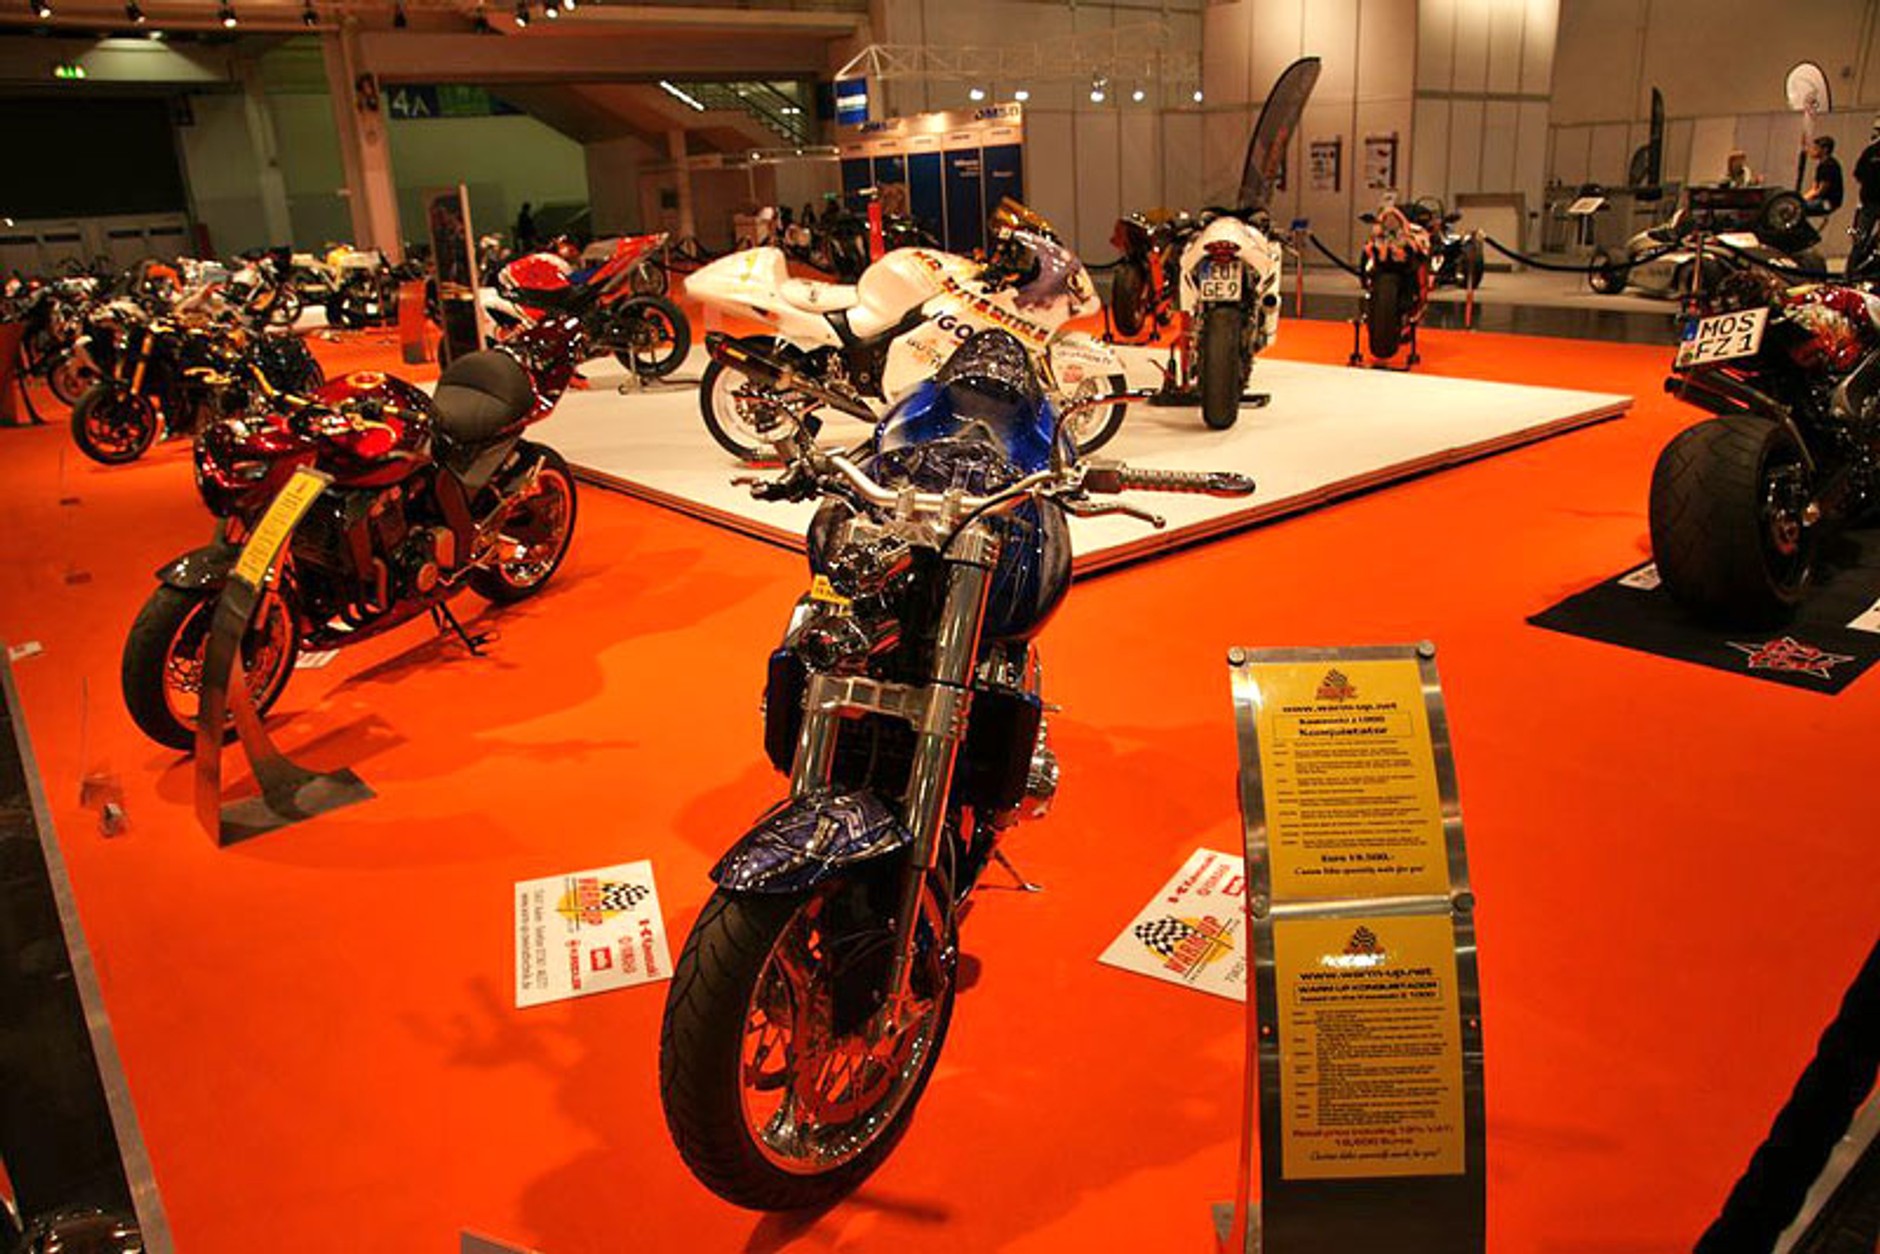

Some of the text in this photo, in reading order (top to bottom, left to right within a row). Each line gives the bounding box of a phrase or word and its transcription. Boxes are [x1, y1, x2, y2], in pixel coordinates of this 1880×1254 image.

[1203, 281, 1238, 298] GE 9
[1700, 312, 1756, 339] MOS
[1695, 333, 1752, 359] FZ 1
[1299, 967, 1432, 981] www.warm-up.net
